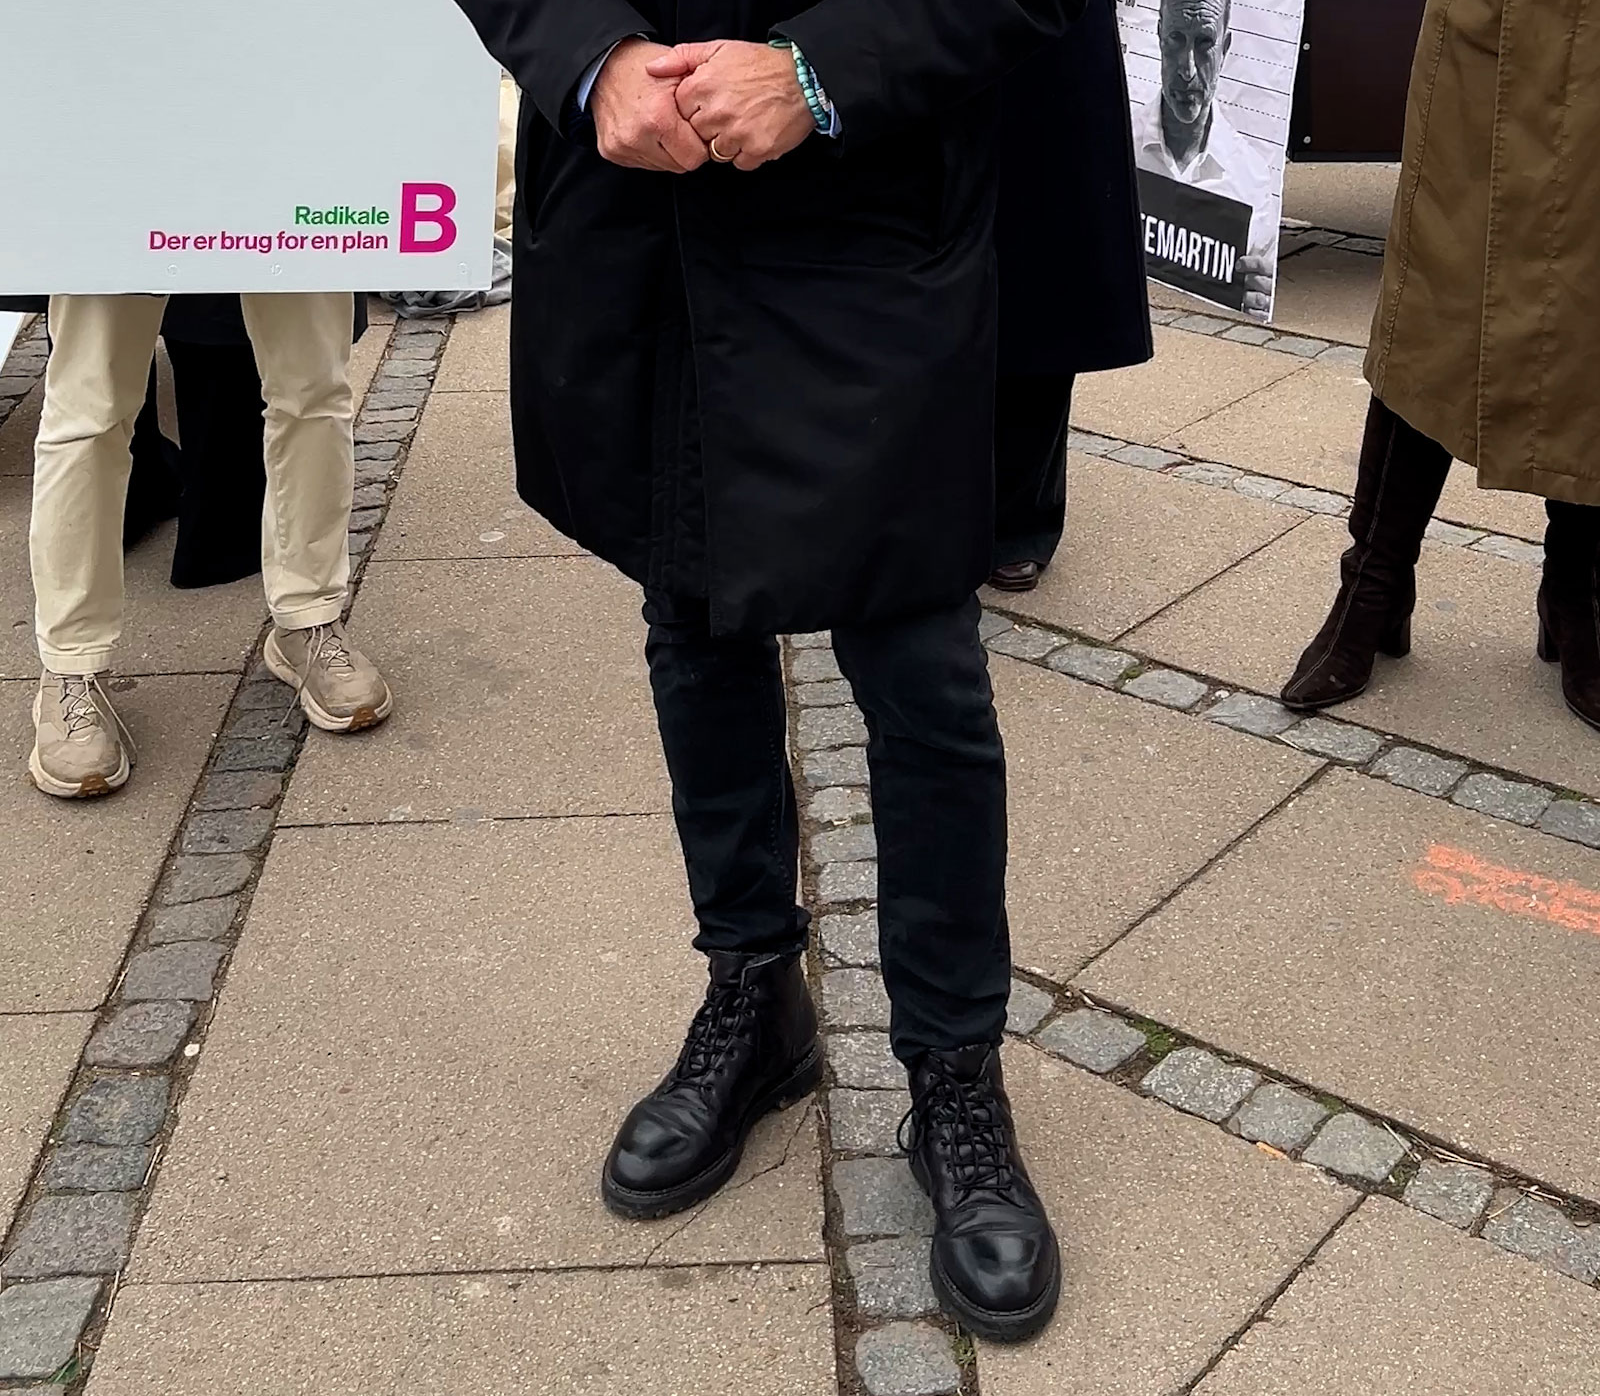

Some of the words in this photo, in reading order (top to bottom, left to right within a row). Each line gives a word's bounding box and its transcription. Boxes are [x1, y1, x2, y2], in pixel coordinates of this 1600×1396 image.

[294, 205, 390, 226] Radikale
[399, 182, 458, 255] B
[149, 231, 191, 250] Der
[193, 235, 217, 250] er
[220, 231, 273, 254] brug
[277, 231, 309, 250] for
[311, 235, 339, 250] en
[342, 231, 389, 254] plan
[1141, 212, 1236, 284] EMARTIN
